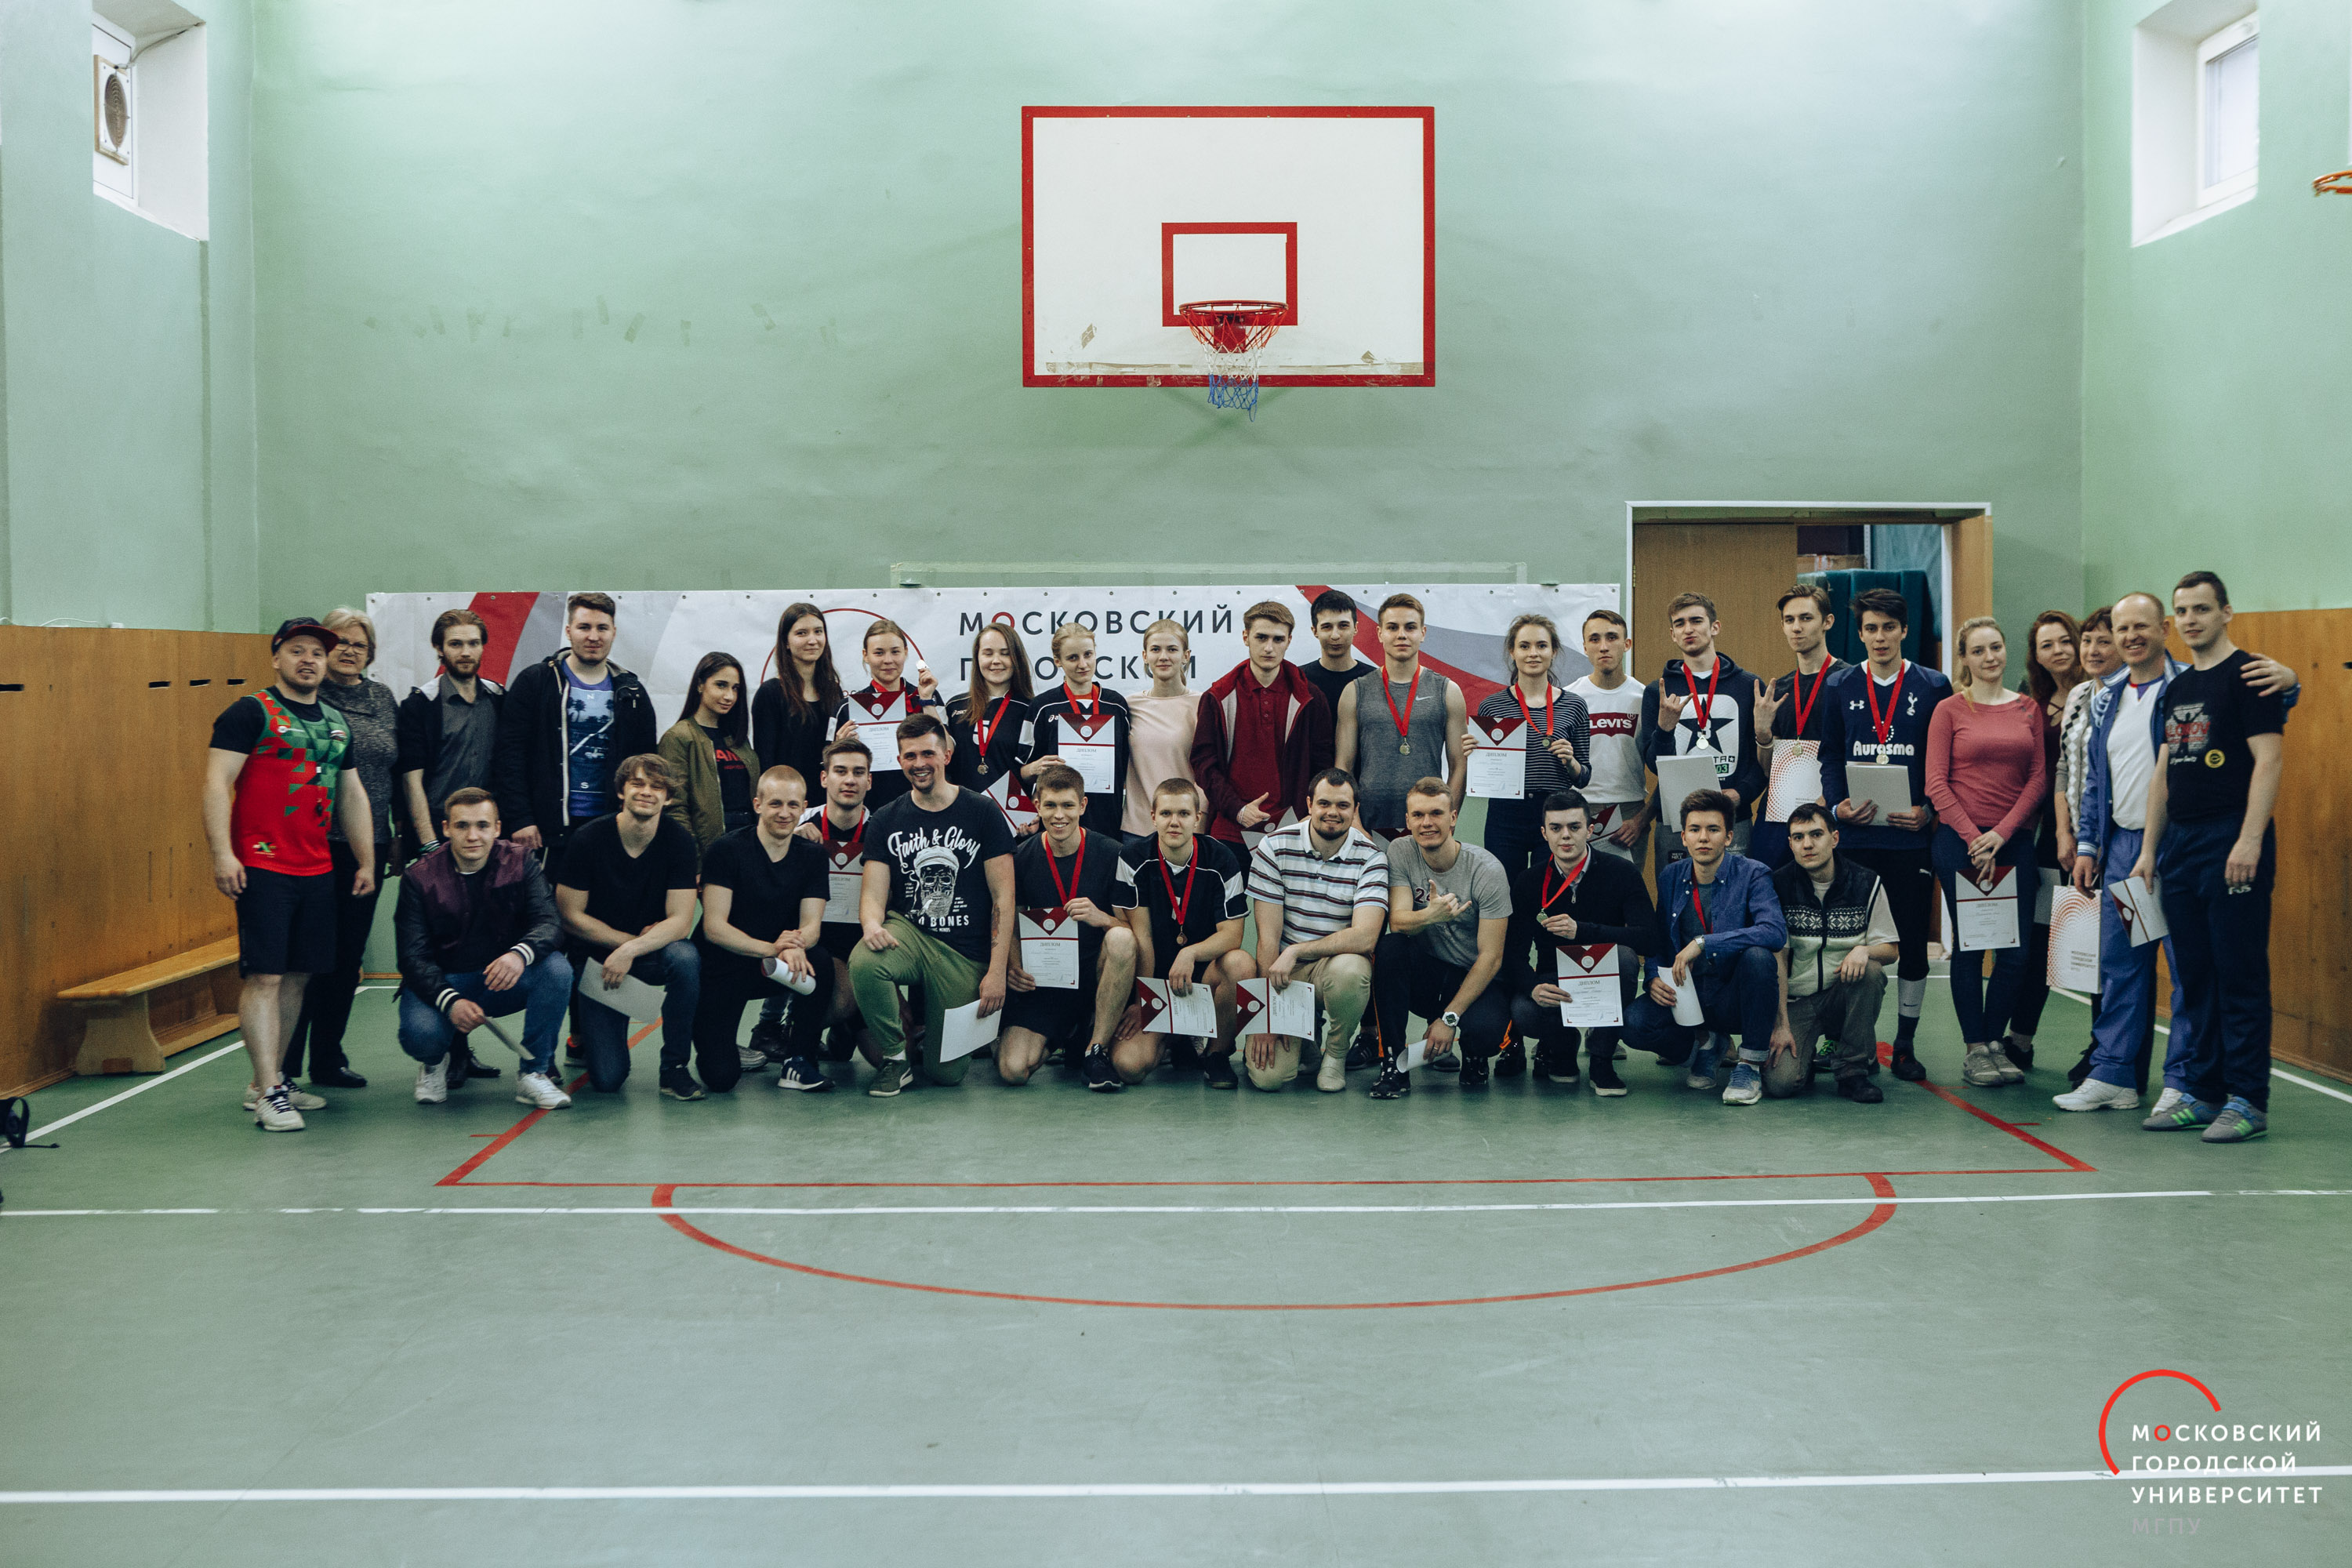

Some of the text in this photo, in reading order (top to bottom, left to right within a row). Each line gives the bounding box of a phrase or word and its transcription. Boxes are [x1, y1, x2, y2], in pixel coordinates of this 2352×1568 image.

[1853, 740, 1915, 757] Aurasma
[887, 826, 981, 869] Faith & Glory
[930, 914, 969, 927] BONES
